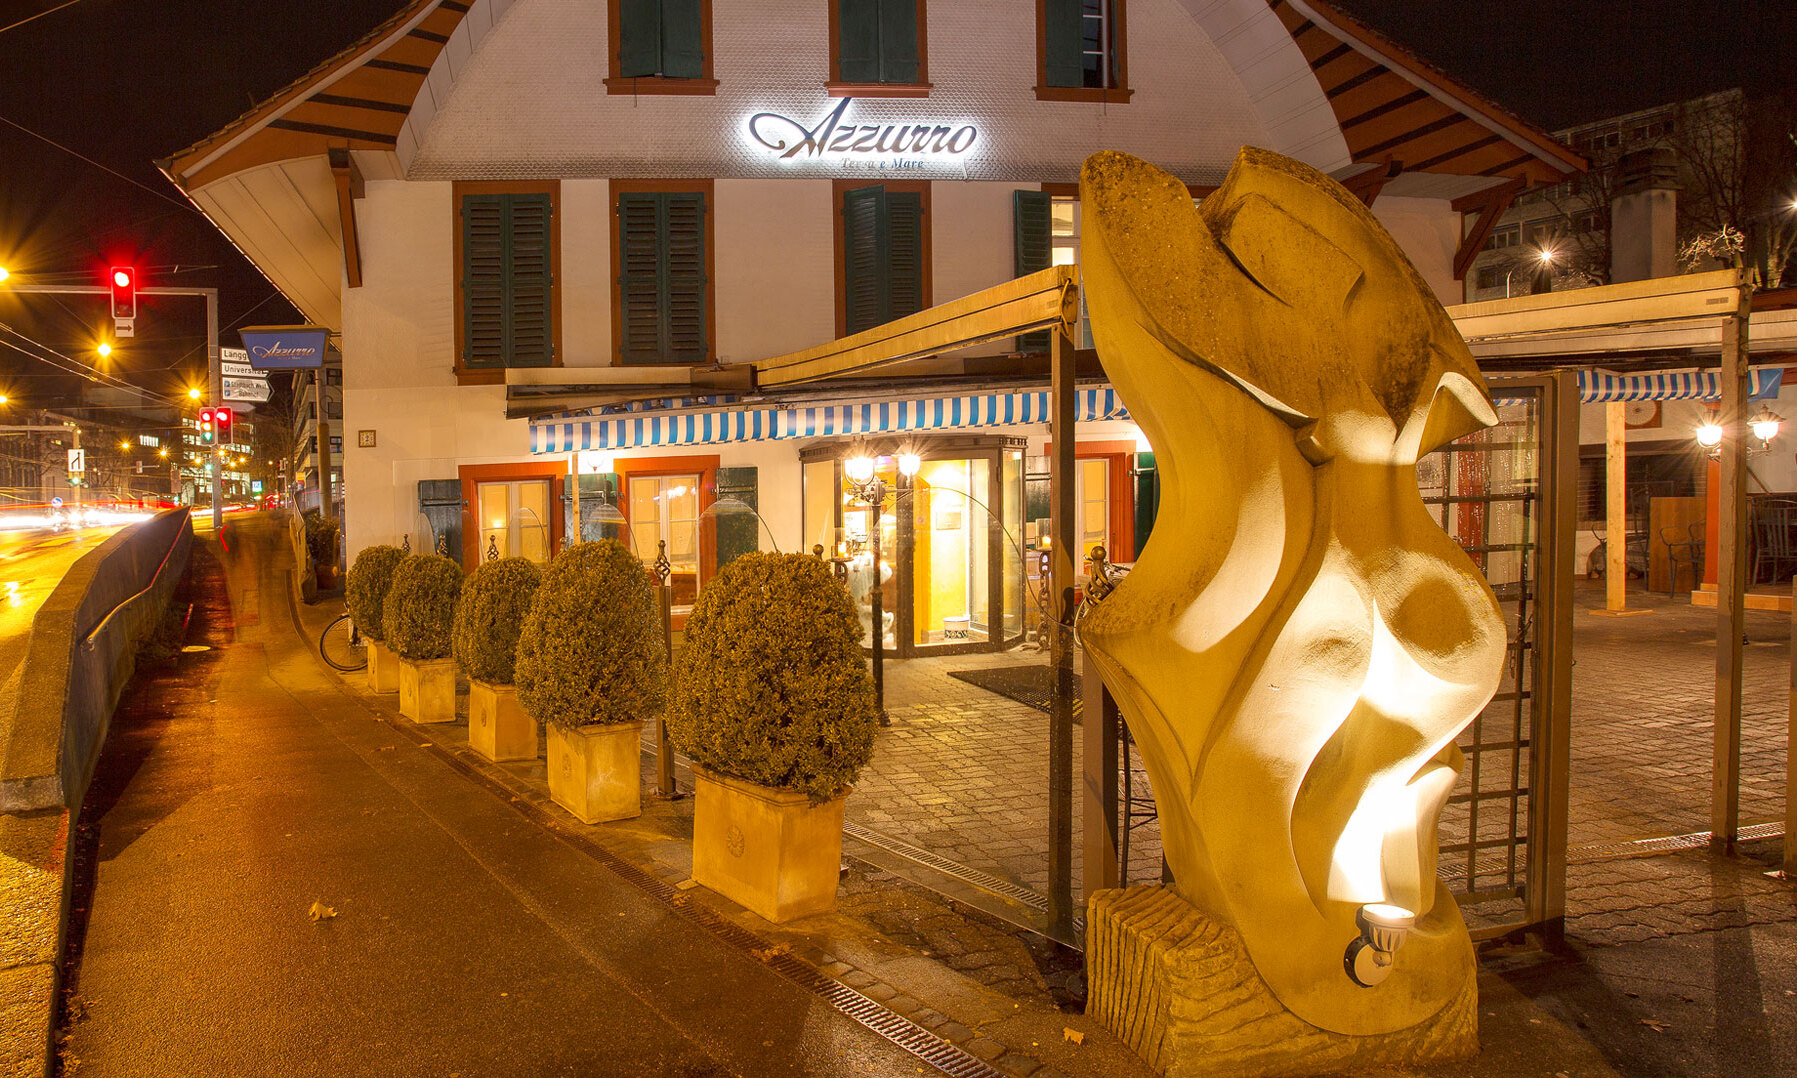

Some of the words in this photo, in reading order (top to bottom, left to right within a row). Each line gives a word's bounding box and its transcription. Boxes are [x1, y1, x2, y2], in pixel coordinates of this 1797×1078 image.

[749, 97, 977, 158] Azzurro
[892, 158, 924, 168] Mare
[252, 341, 316, 358] Azzurro
